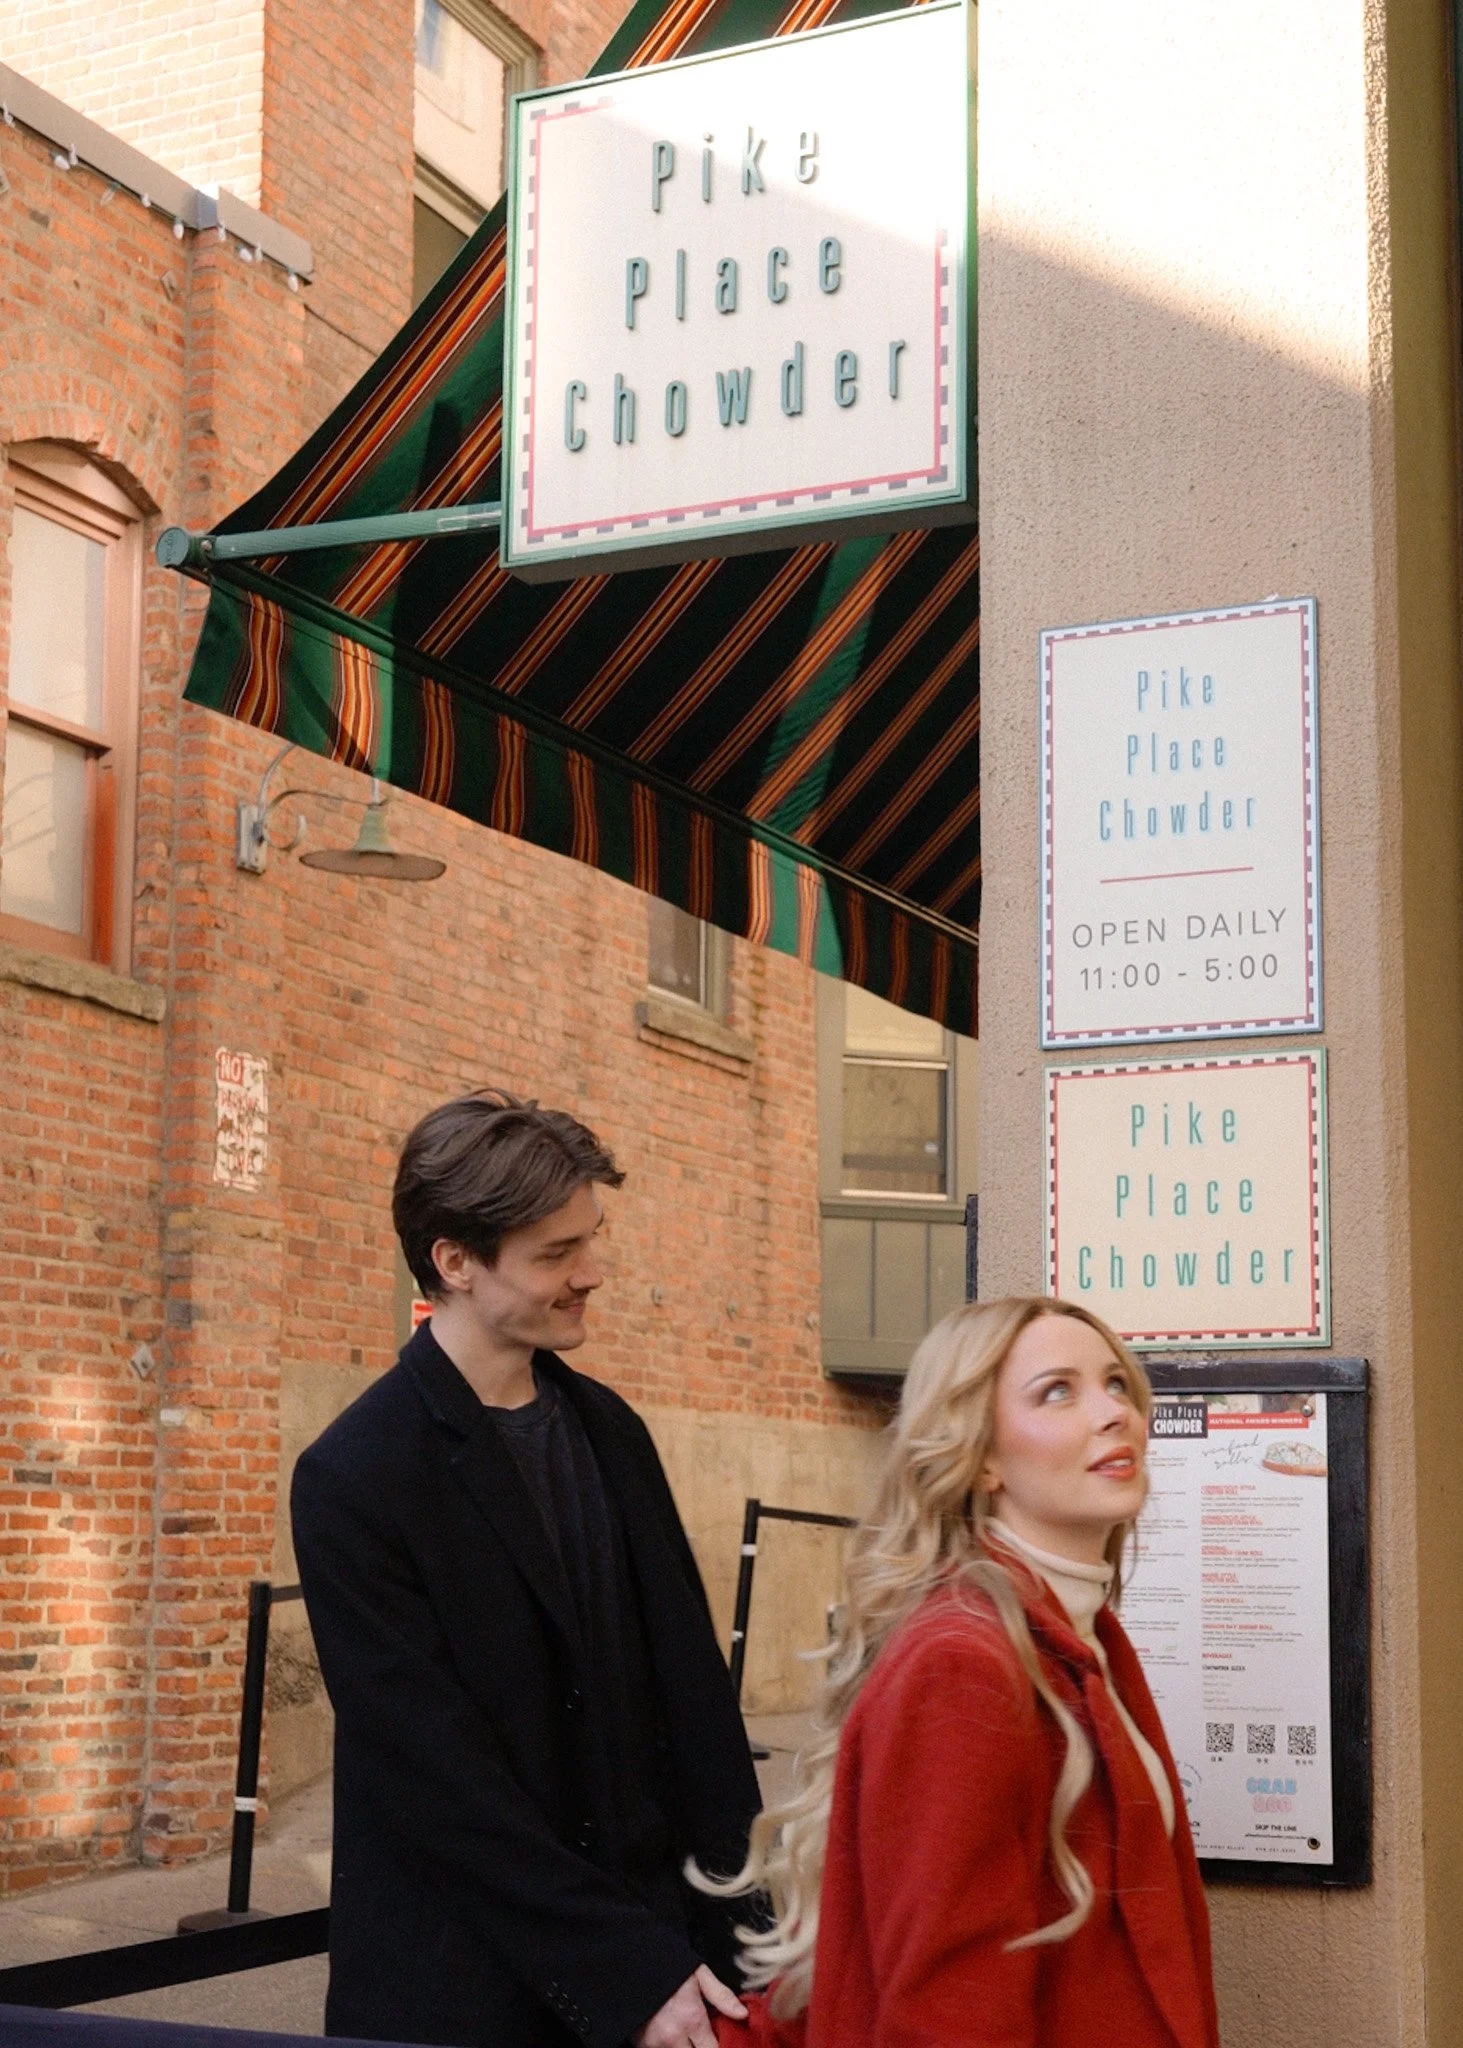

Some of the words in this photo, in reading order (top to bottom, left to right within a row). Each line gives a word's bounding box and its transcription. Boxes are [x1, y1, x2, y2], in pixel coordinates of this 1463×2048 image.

[651, 126, 820, 213] Pike
[624, 236, 841, 330] Place
[563, 340, 906, 452] Chowder
[1137, 667, 1214, 712] Pike
[1126, 733, 1225, 775] Place
[1099, 791, 1256, 842] Chowder
[1072, 918, 1167, 949] OPEN
[1187, 907, 1287, 940] DAILY
[1079, 962, 1161, 991] 11:00
[1205, 953, 1279, 982] 5:00
[1131, 1101, 1236, 1147] Pike
[1116, 1173, 1253, 1218] Place
[1078, 1240, 1294, 1290] Chowder
[1153, 1418, 1203, 1434] CHOWDER
